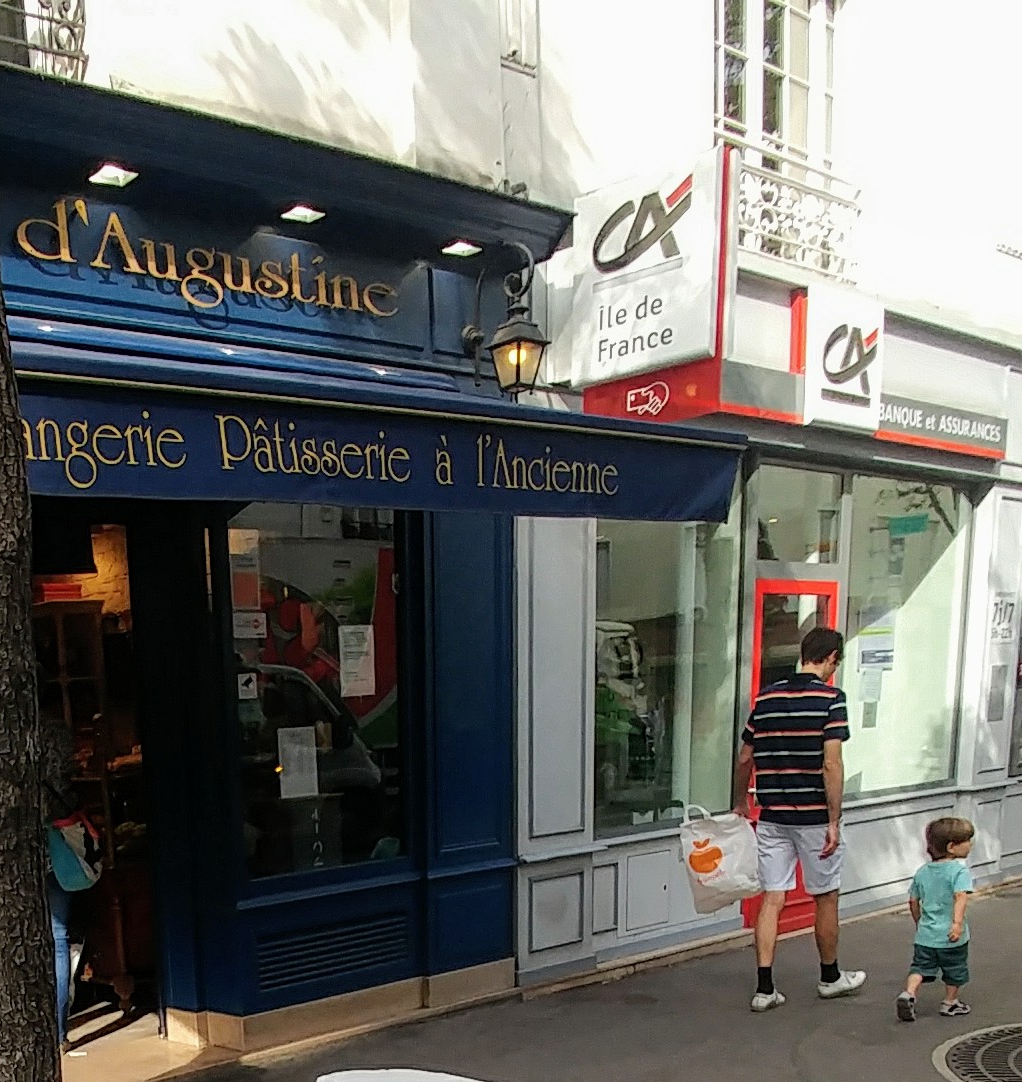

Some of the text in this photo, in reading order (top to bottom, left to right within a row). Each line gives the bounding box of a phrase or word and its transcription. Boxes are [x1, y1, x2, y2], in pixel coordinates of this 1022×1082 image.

[17, 197, 400, 318] d'Augustine
[599, 295, 663, 331] Île de
[598, 328, 673, 362] France
[879, 403, 1002, 442] BANQUE et ASSURANCES
[219, 413, 411, 483] Pâtisserie
[434, 439, 454, 485] à
[477, 437, 620, 497] l'Ancienne
